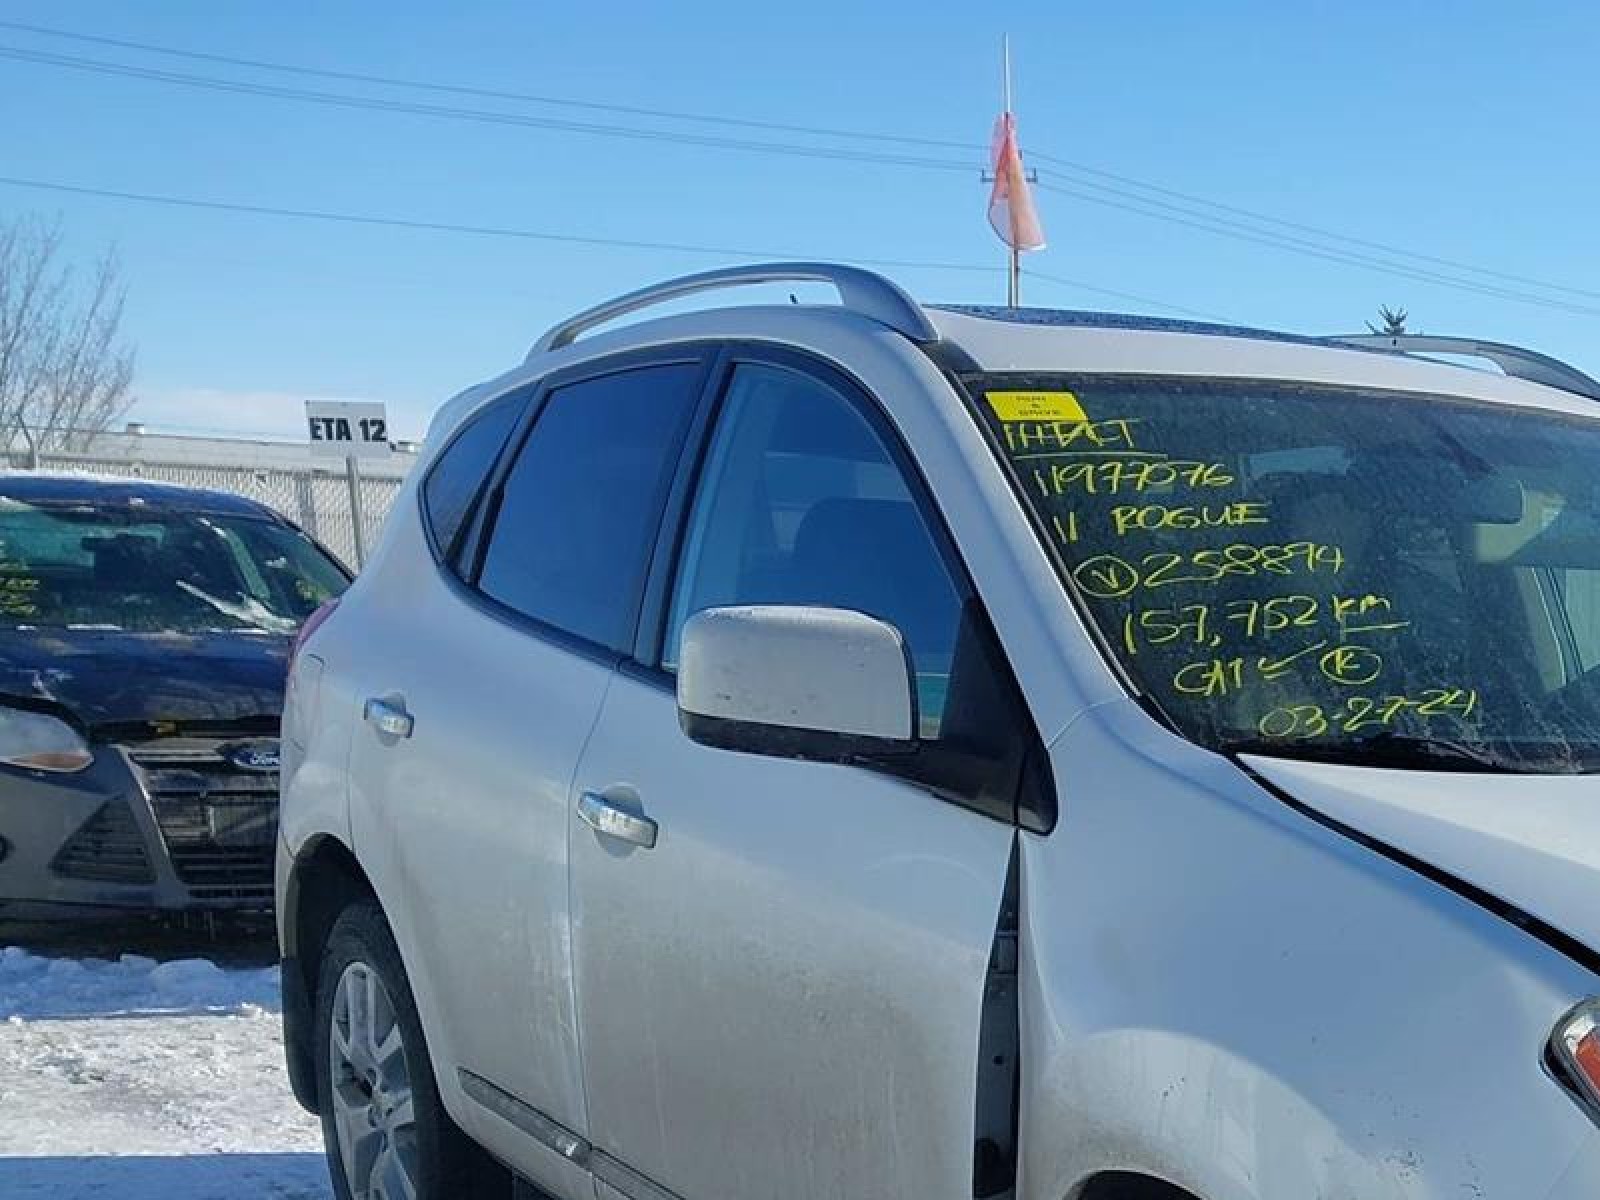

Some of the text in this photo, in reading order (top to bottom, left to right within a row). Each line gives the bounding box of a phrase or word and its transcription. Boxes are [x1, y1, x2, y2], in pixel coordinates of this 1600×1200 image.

[309, 417, 387, 442] ETA 12
[1034, 460, 1235, 497] 11977076
[1053, 501, 1272, 544] 11 ROGUE
[1142, 543, 1345, 588] 258894
[1123, 595, 1319, 655] 157,752
[1259, 689, 1477, 738] 03-27-24
